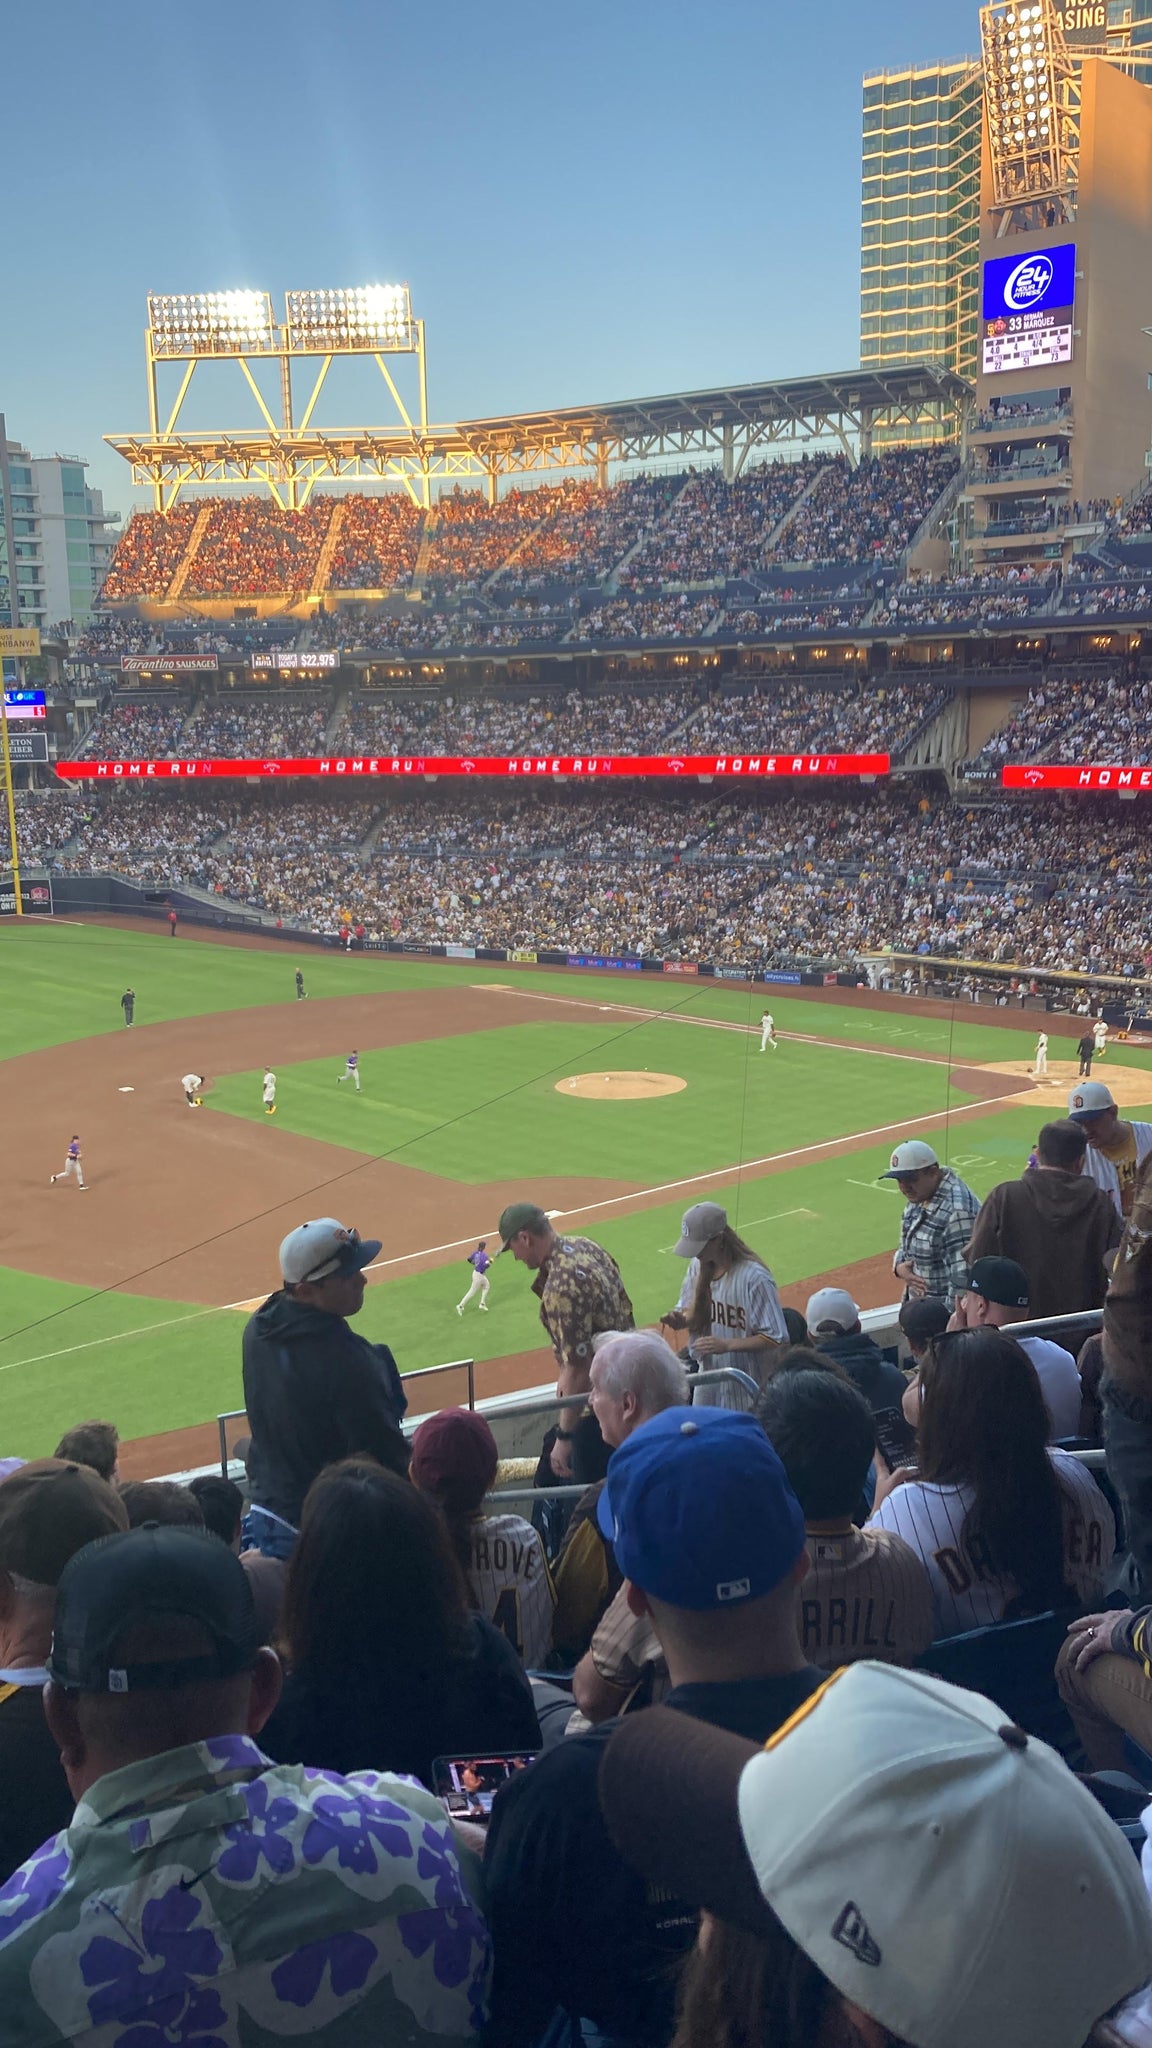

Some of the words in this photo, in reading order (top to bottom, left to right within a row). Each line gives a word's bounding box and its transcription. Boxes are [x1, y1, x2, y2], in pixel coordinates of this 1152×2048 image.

[1016, 265, 1049, 289] 24
[1013, 288, 1041, 299] FITNESS
[1015, 284, 1035, 293] HOUR
[1009, 317, 1022, 331] 33
[124, 657, 174, 670] Tarantino
[176, 660, 216, 668] SAUSAGES
[301, 654, 335, 667] $22,975
[98, 764, 156, 775] HOME
[170, 763, 212, 774] RUN
[320, 760, 379, 772] HOME
[391, 760, 425, 771] RUN
[508, 760, 561, 771] HOME
[573, 760, 612, 771] RUN
[716, 759, 777, 771] HOME
[792, 759, 838, 771] RUN
[1079, 770, 1152, 785] HOME
